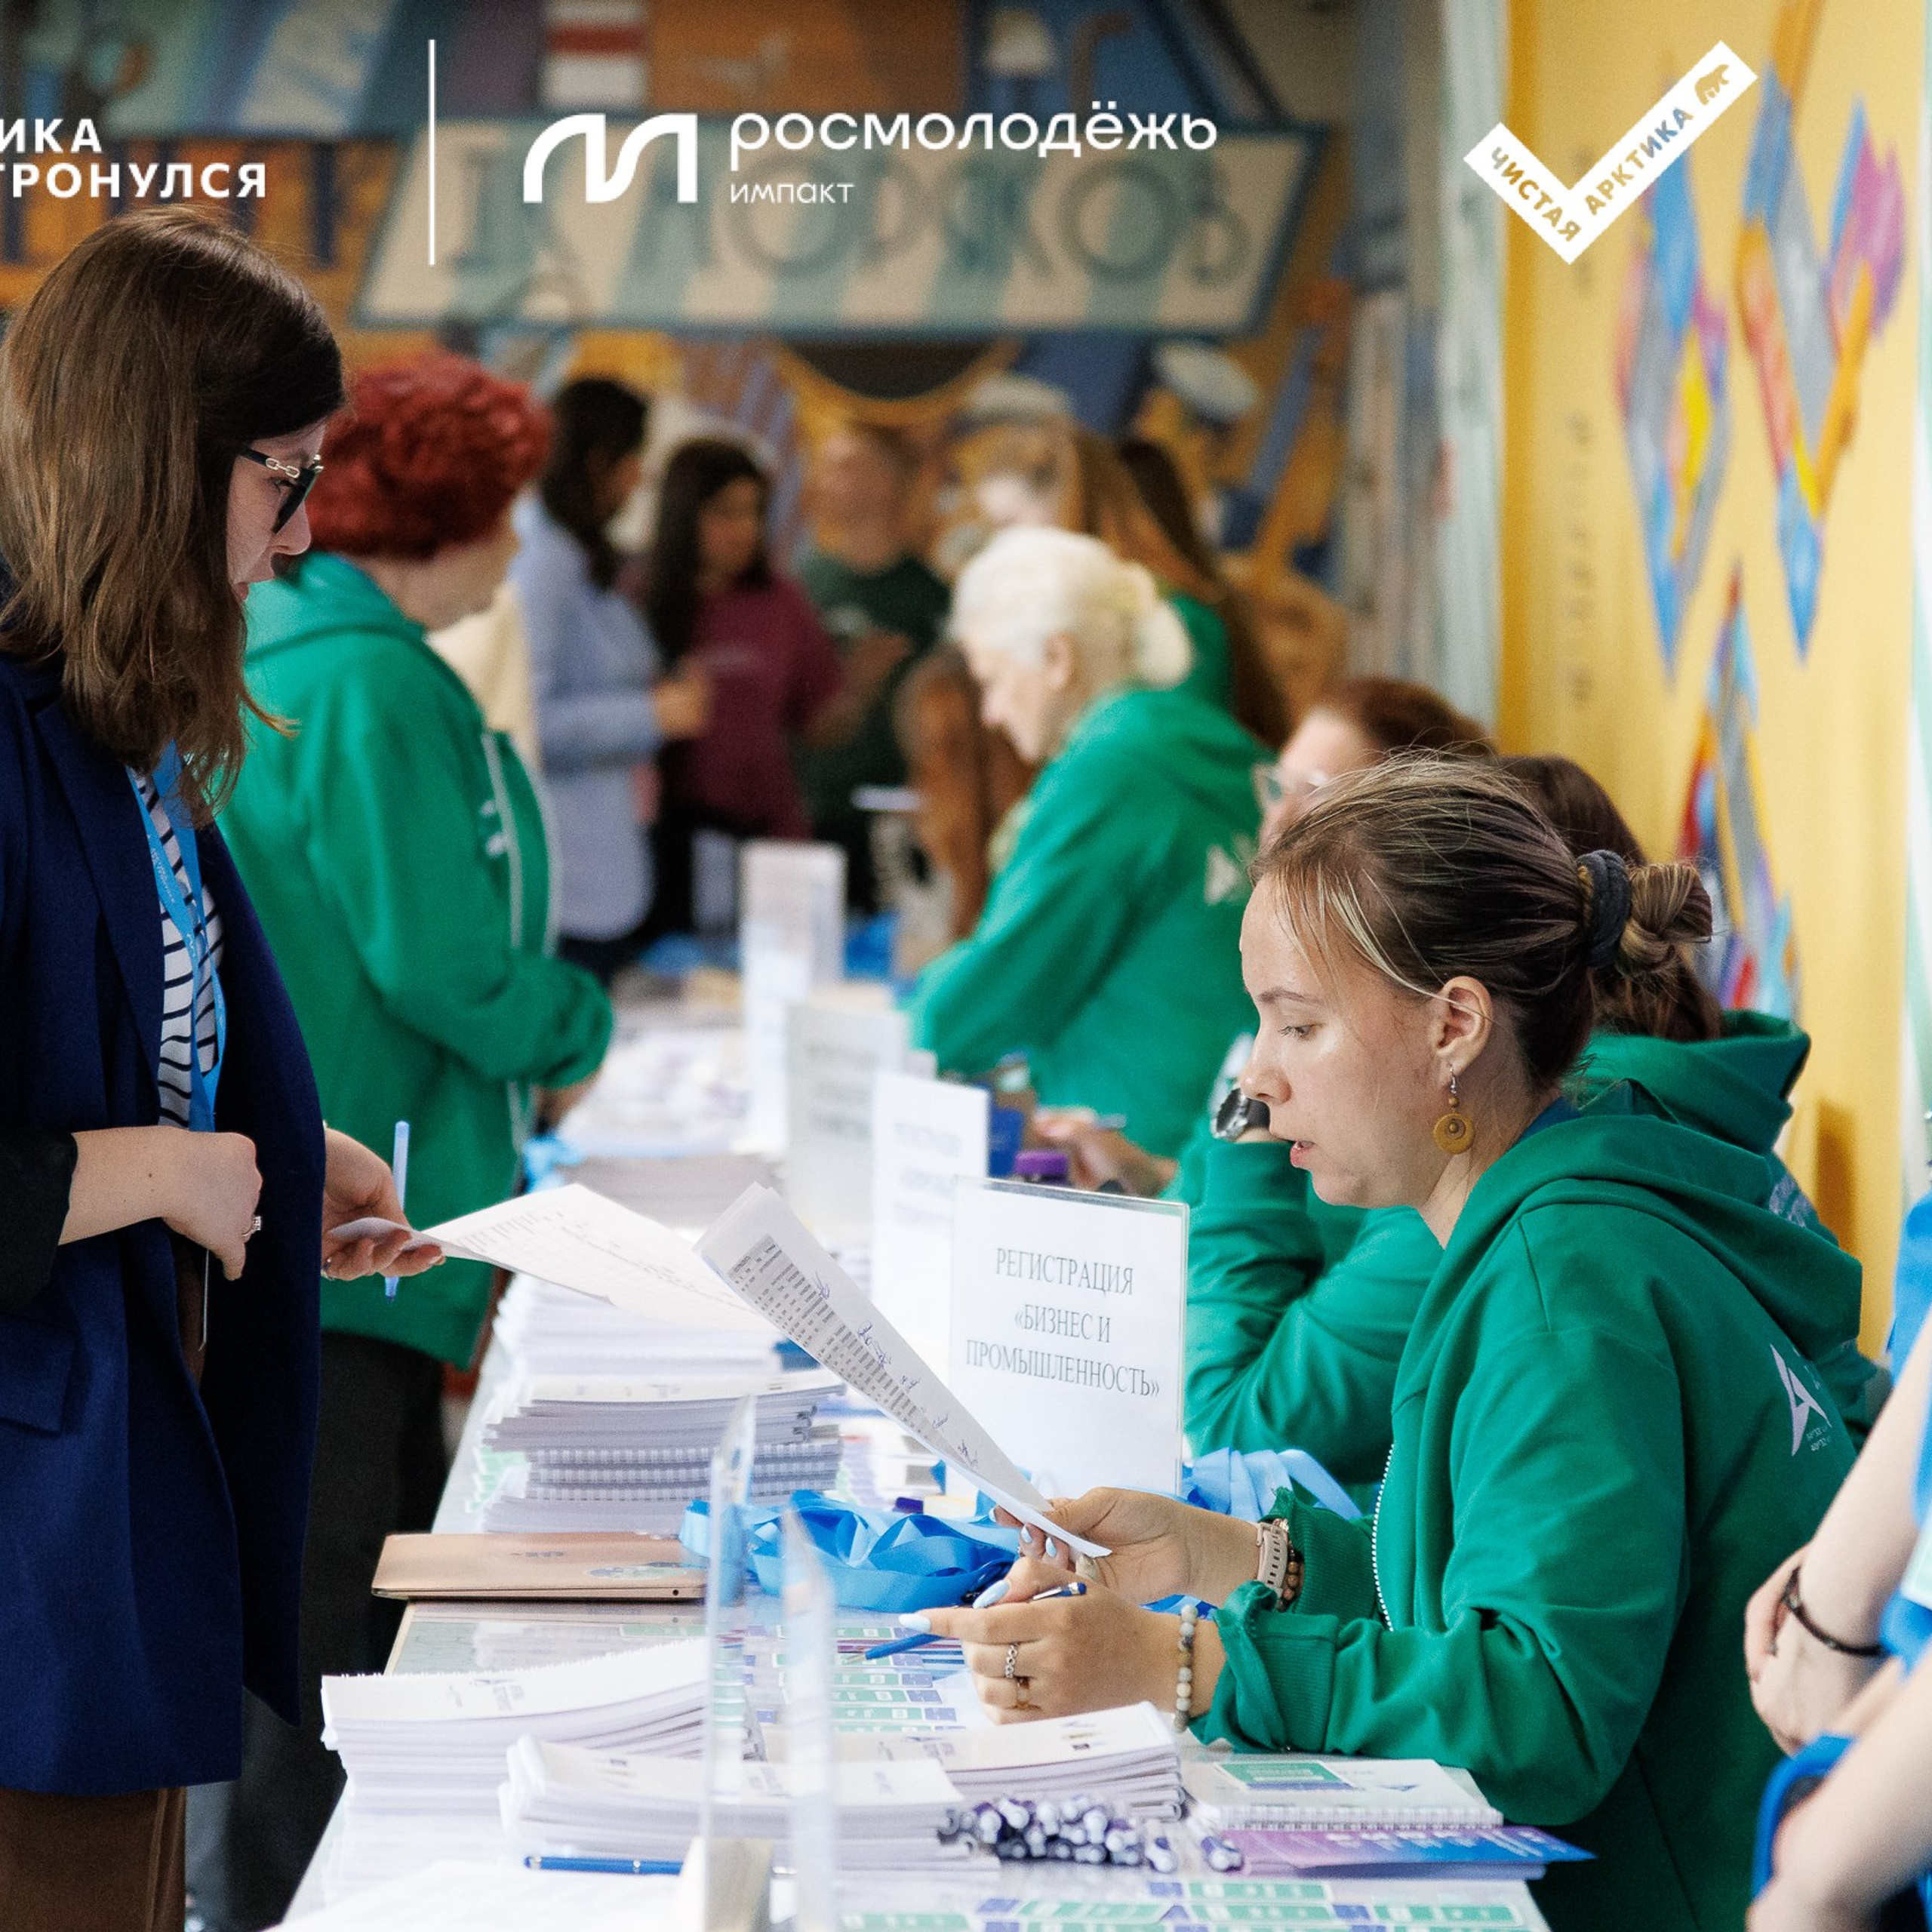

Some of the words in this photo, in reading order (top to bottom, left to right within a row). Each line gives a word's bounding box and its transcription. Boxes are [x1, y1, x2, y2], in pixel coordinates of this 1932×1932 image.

[995, 1247, 1134, 1296] РЕГИСТРАЦИЯ
[1015, 1303, 1093, 1340] «БИЗНЕС
[1098, 1316, 1111, 1343] И
[966, 1340, 1160, 1396] ПРОМЫШЛЕННОСТЬ»
